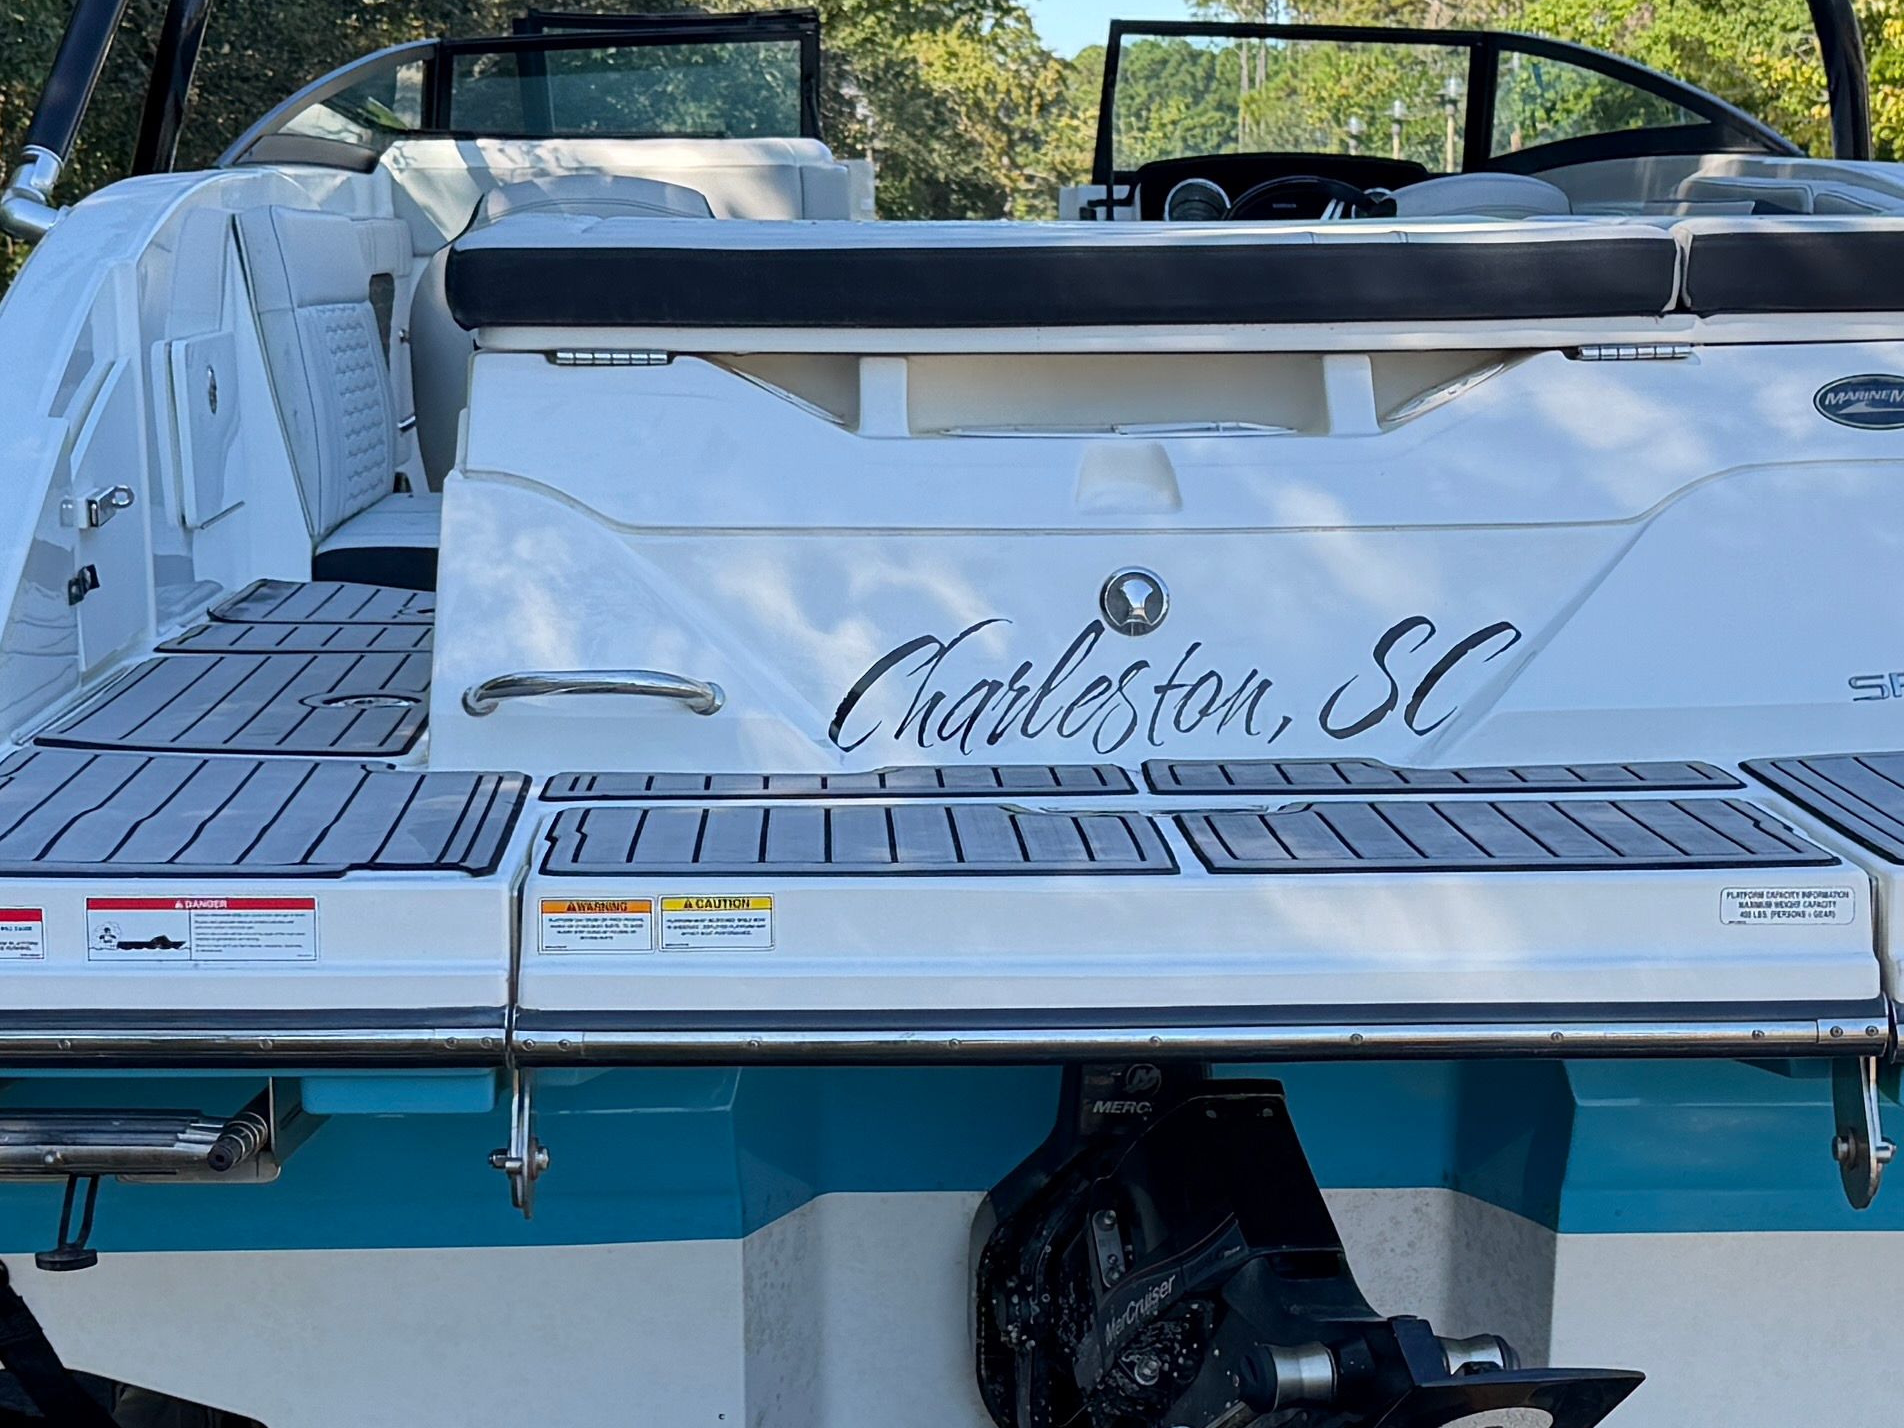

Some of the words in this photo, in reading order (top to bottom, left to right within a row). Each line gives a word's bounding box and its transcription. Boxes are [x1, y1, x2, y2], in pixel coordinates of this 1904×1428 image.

[828, 618, 1294, 756] Charleston,
[1317, 614, 1524, 741] SC
[184, 899, 228, 909] DANGER
[577, 901, 628, 912] WARNING
[696, 898, 750, 909] CAUTION
[1092, 1100, 1153, 1115] MERC
[1105, 1274, 1176, 1347] MerCruiser
